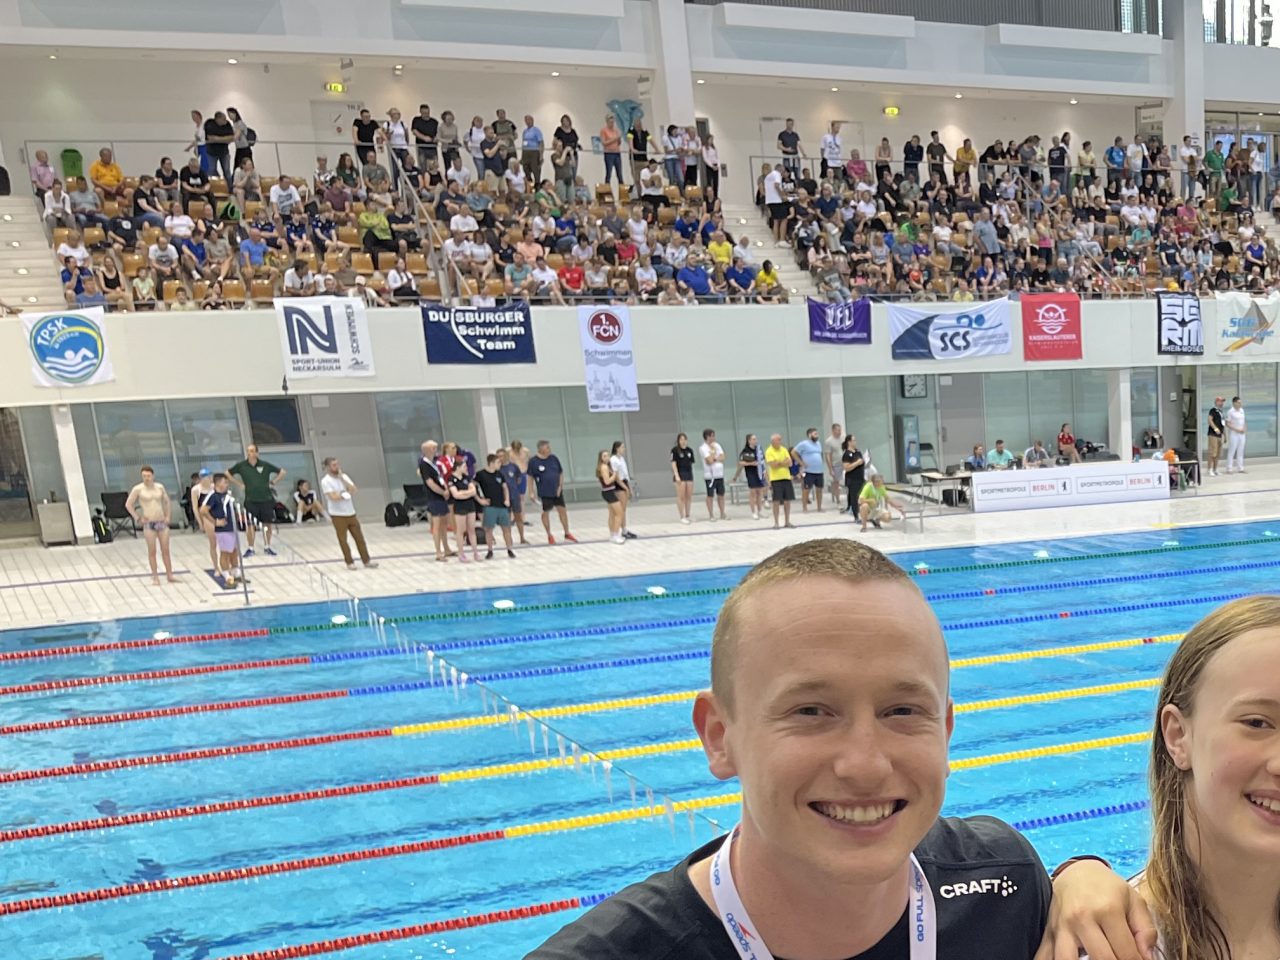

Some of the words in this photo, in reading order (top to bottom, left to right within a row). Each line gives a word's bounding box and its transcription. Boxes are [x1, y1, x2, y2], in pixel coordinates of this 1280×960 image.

[457, 325, 526, 336] Schwimm
[592, 324, 619, 337] FCN
[477, 339, 517, 350] Team
[940, 331, 972, 352] SCS
[1032, 484, 1056, 492] BERLIN
[1129, 478, 1152, 486] BERLIN
[940, 879, 1001, 899] CRAFT
[725, 912, 751, 952] speedo
